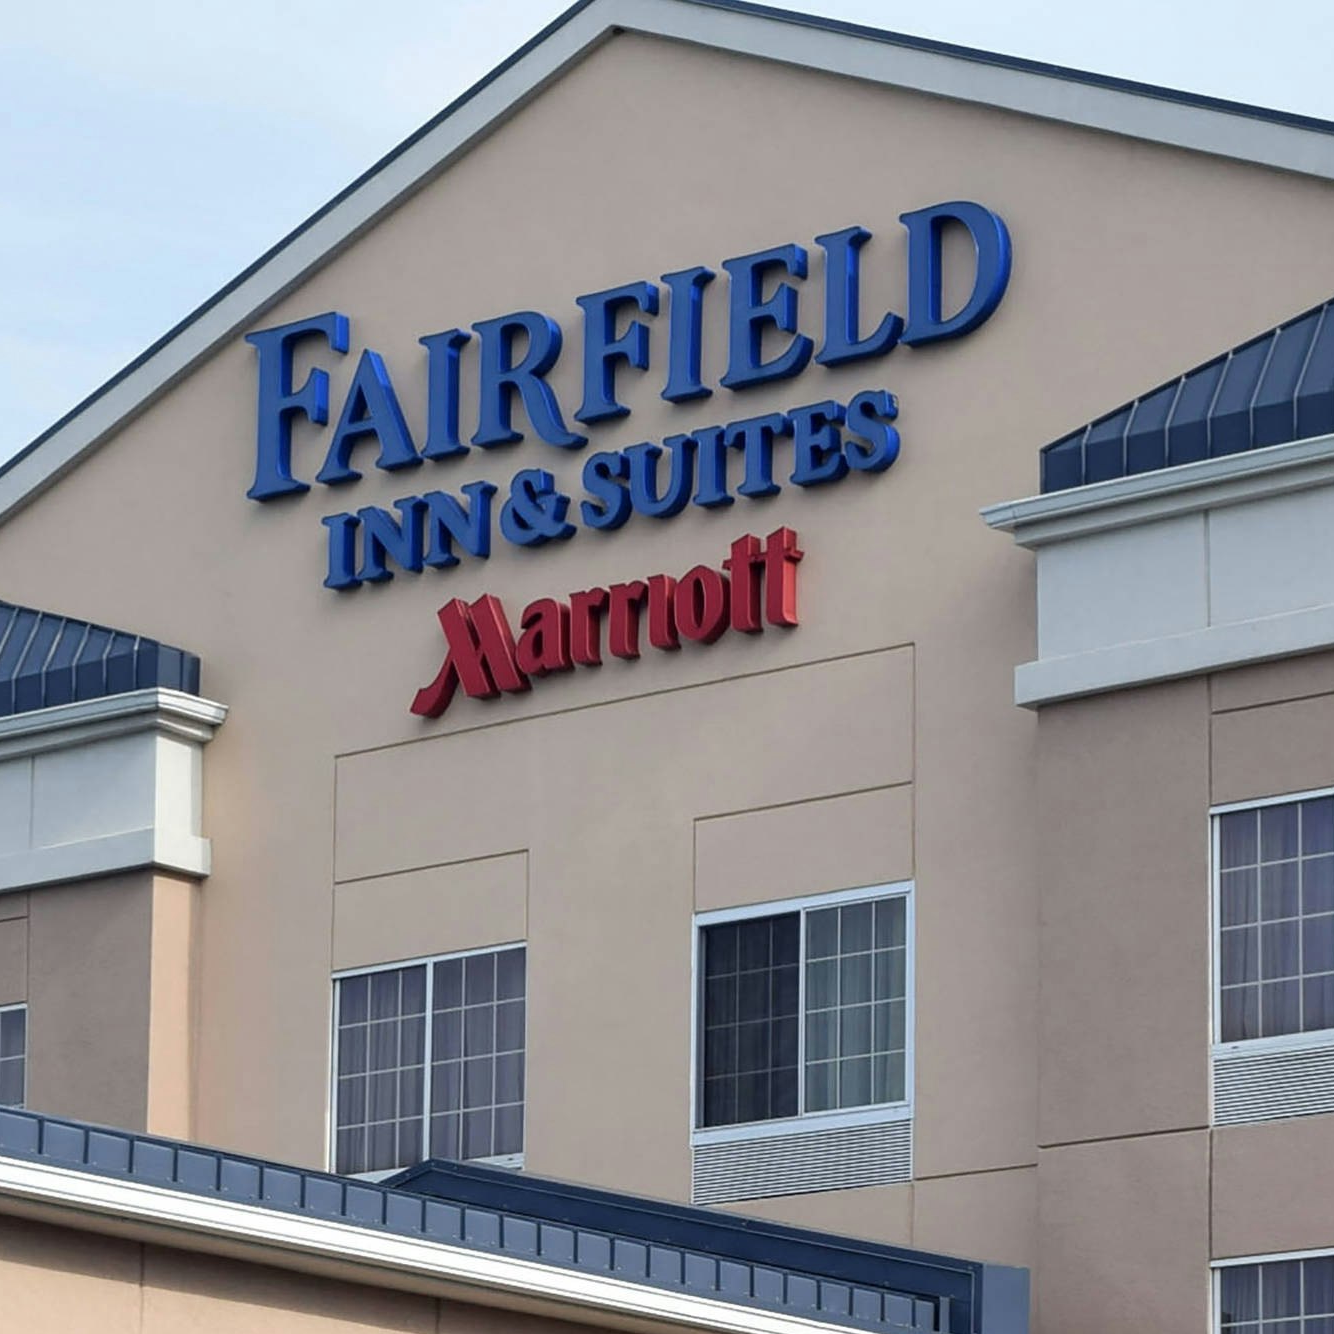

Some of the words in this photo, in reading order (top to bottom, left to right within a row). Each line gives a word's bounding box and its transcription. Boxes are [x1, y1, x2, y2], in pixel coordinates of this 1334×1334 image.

[245, 200, 1013, 502] FAIRFIELD
[321, 481, 497, 590] INN
[580, 390, 900, 529] SUITES
[410, 526, 804, 718] Marriott
